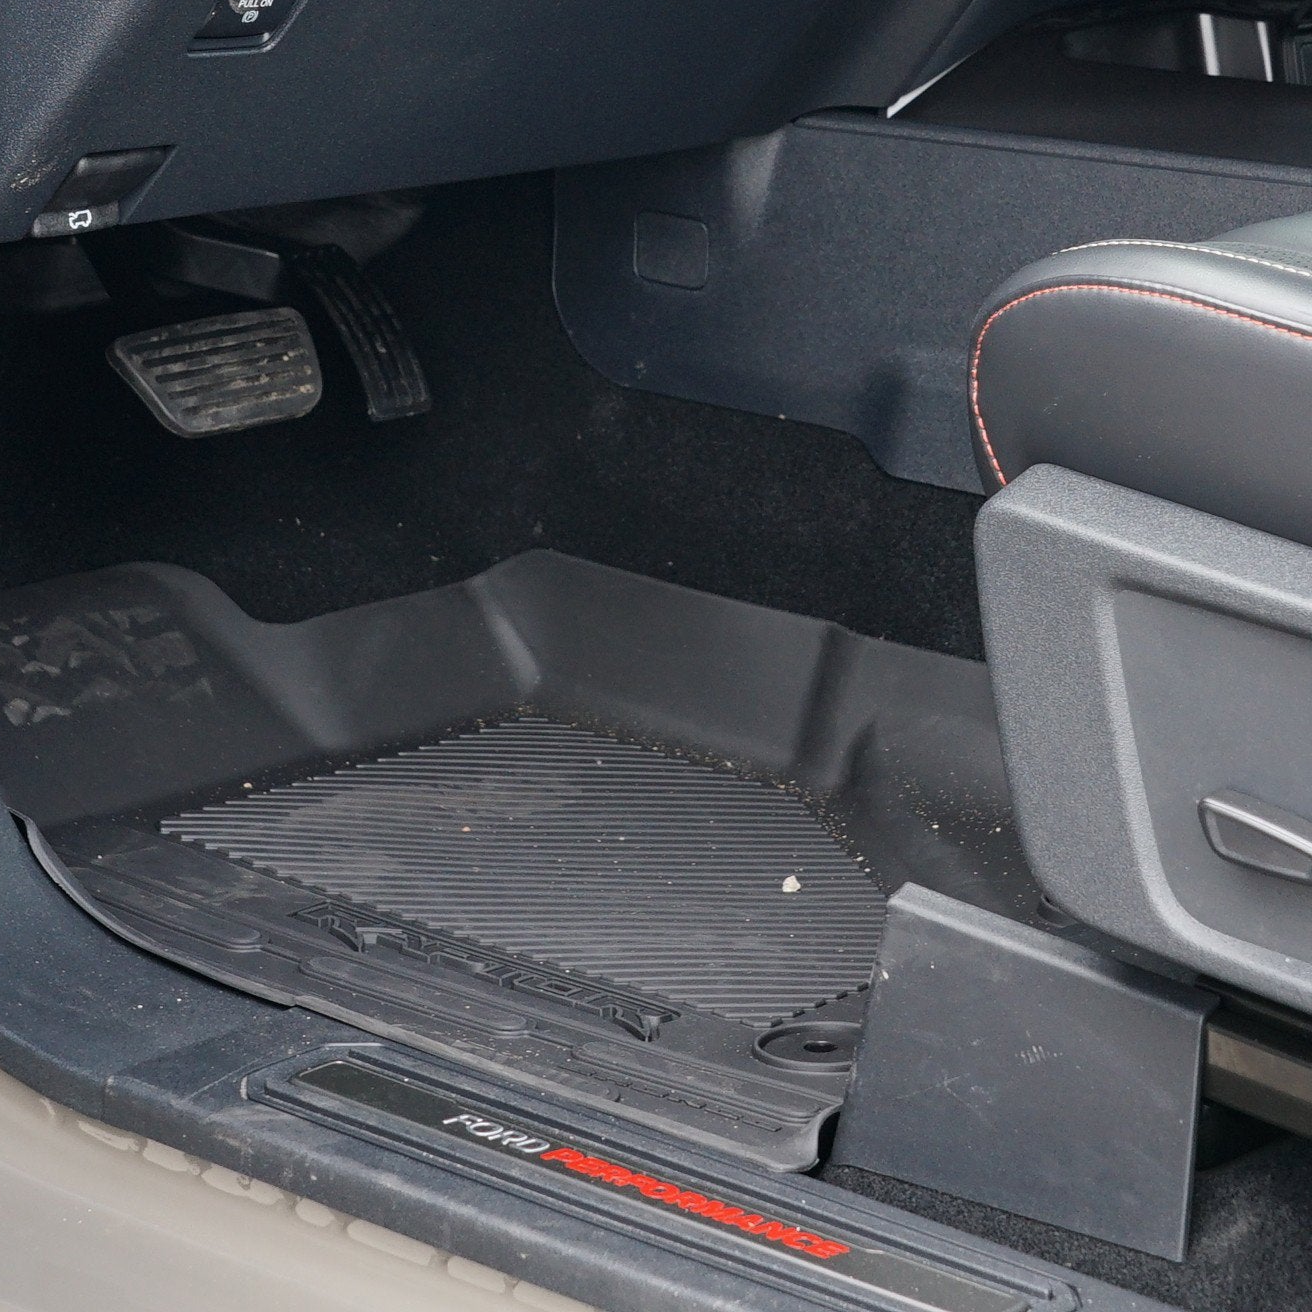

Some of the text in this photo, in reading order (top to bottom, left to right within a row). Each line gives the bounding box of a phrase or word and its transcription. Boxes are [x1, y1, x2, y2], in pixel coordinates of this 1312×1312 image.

[237, 0, 259, 8] PULL
[442, 1112, 851, 1260] FORD PERFORMANCE
